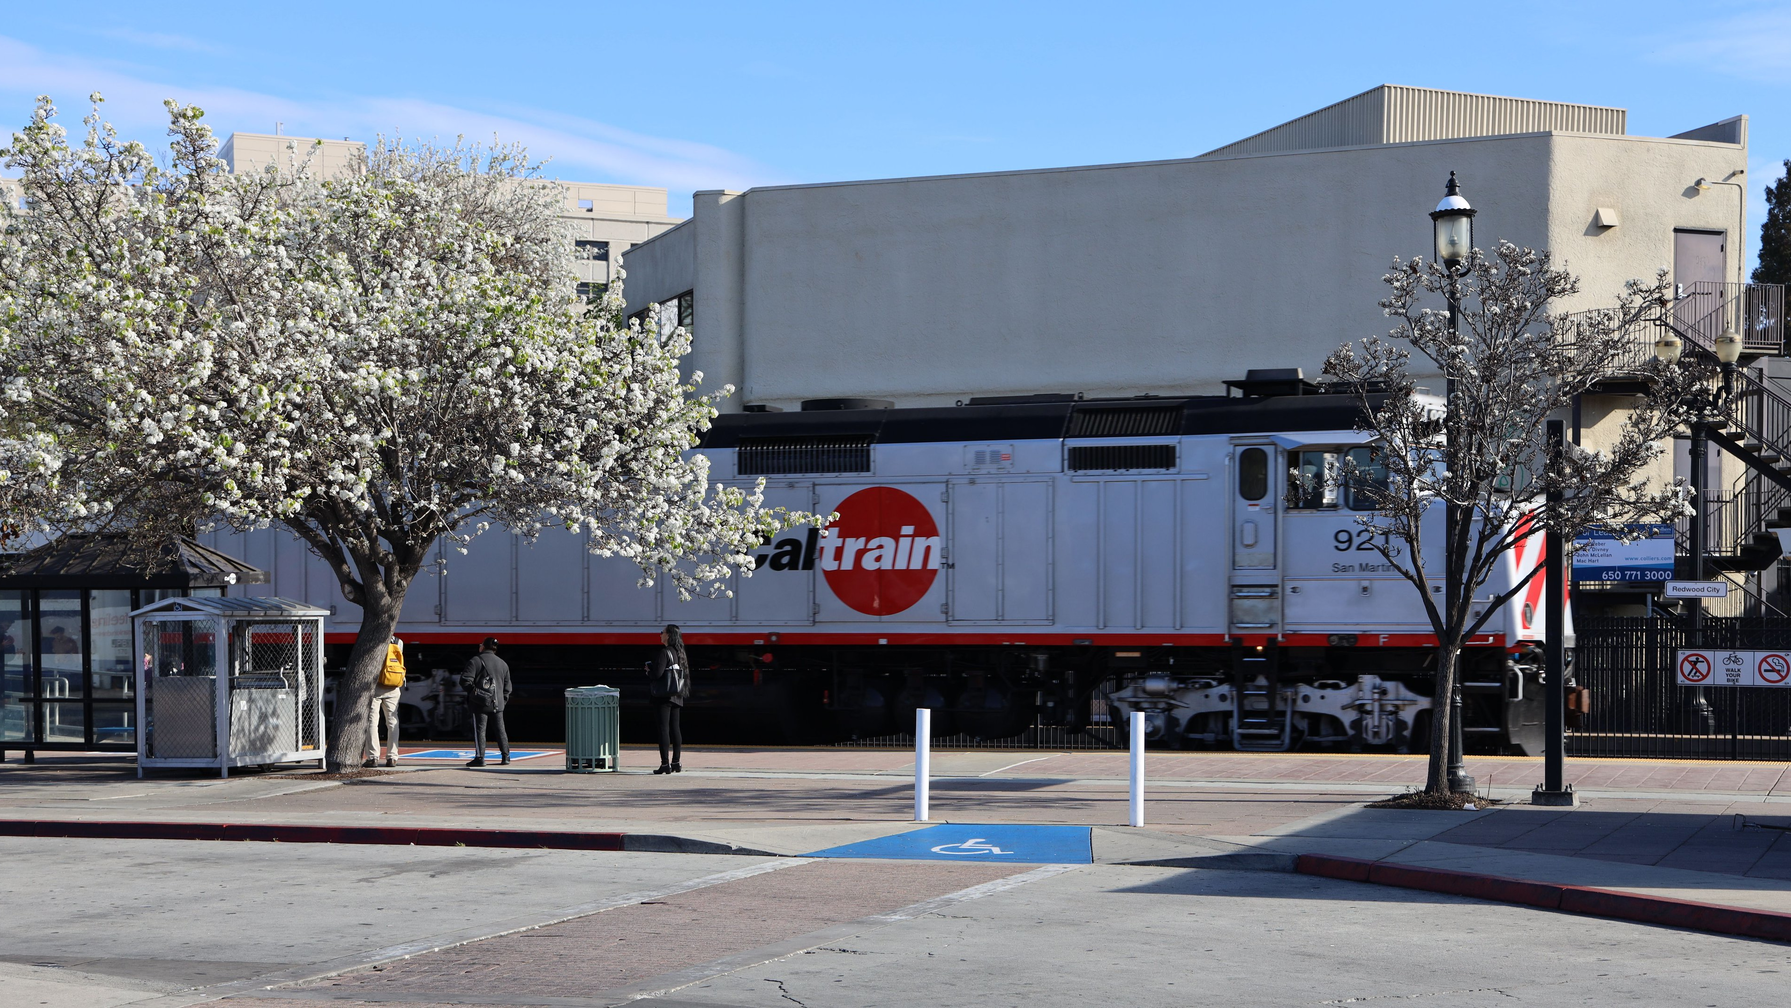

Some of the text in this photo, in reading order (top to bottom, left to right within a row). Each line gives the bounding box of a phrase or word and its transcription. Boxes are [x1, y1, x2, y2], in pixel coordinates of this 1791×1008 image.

[1331, 562, 1355, 573] San
[1602, 571, 1672, 580] 650 771 3000
[1672, 585, 1721, 594] Redwood City
[1379, 634, 1390, 646] F
